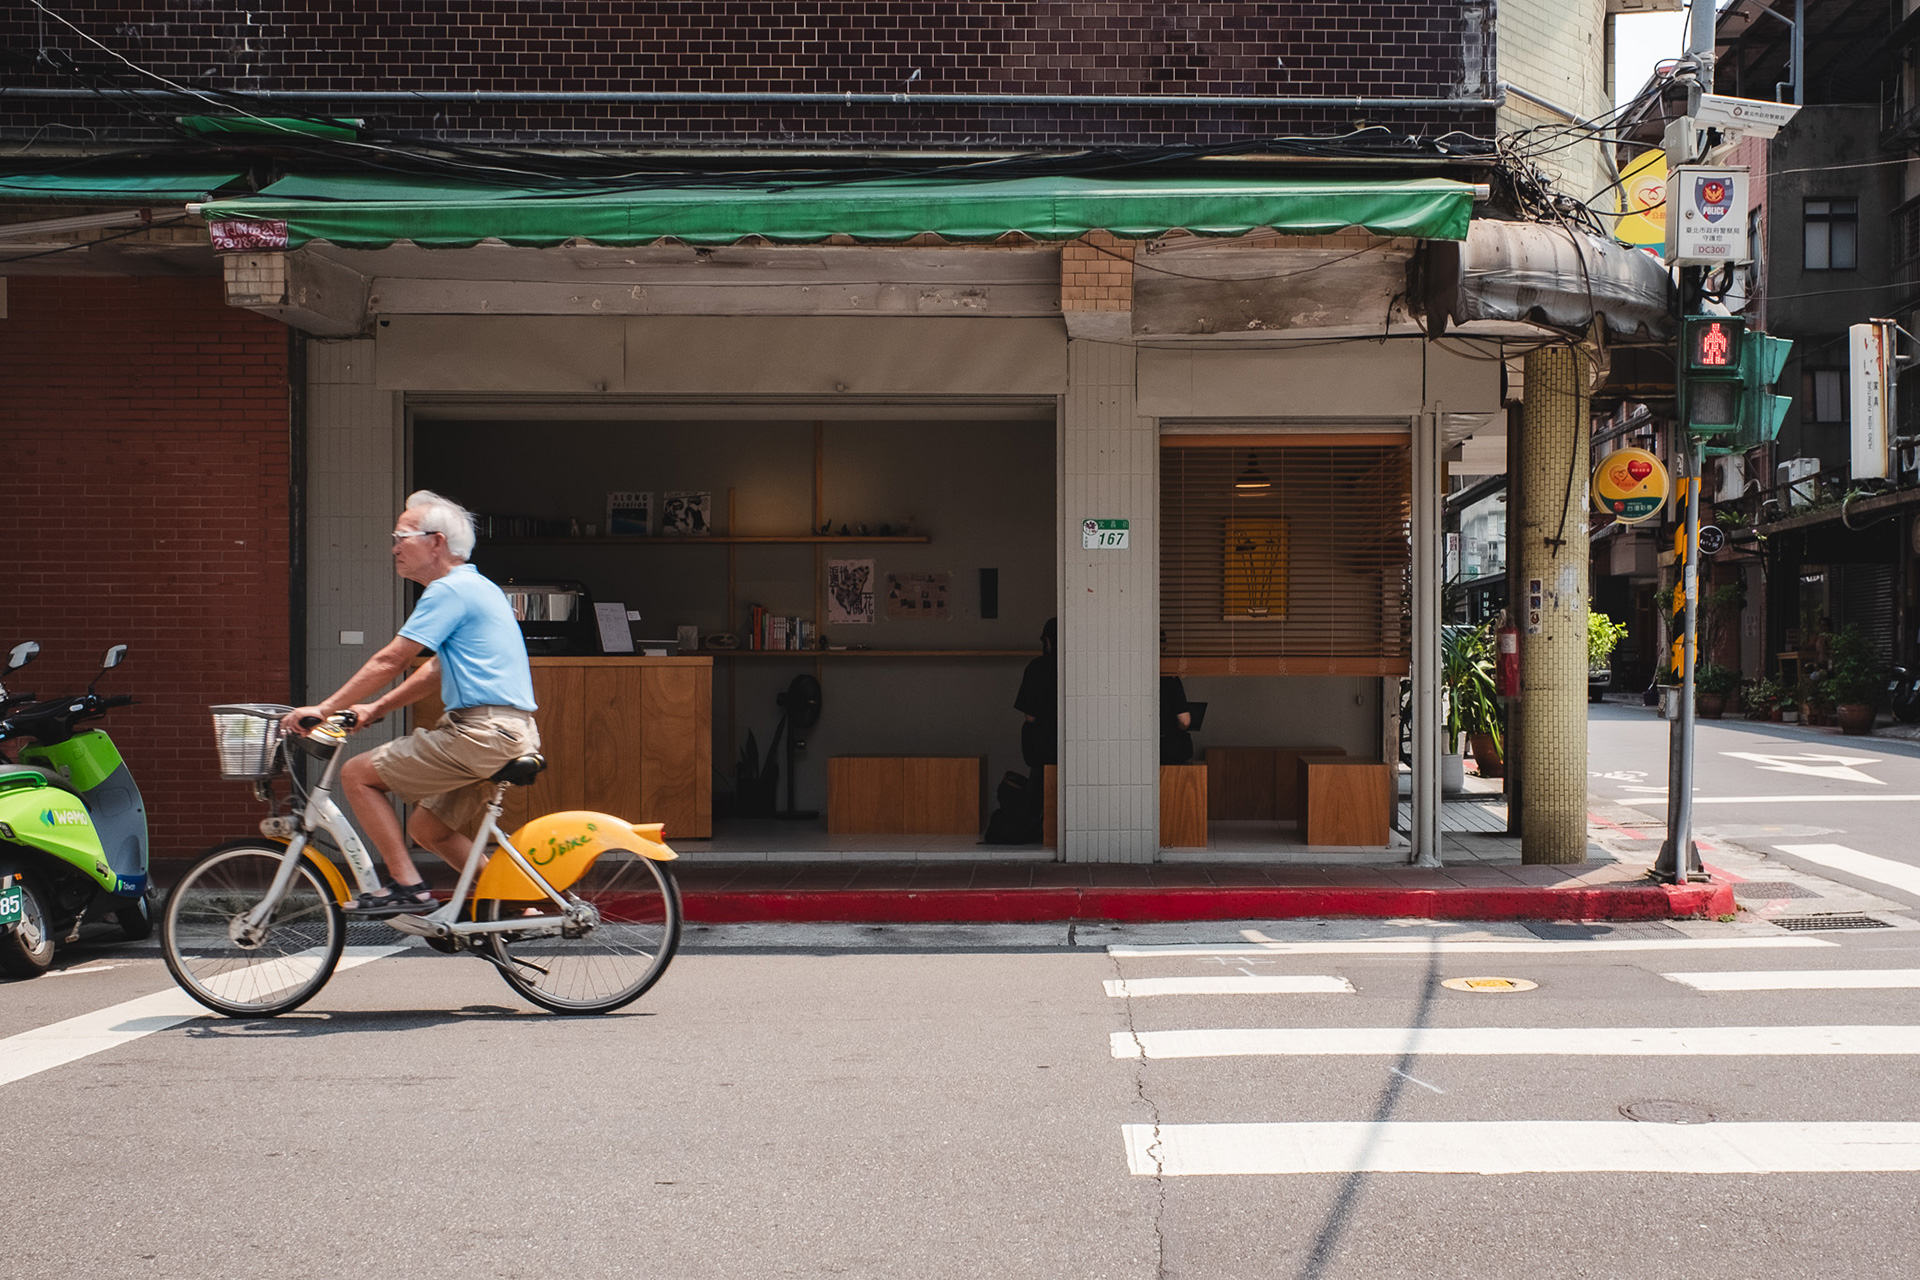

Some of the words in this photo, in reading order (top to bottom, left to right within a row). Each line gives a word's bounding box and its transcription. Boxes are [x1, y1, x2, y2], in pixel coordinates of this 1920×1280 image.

[1702, 206, 1725, 215] POLICE
[1686, 227, 1740, 235] 臺北市政府警察局
[1698, 245, 1726, 254] DC300
[1099, 533, 1124, 545] 167
[0, 894, 20, 916] 85
